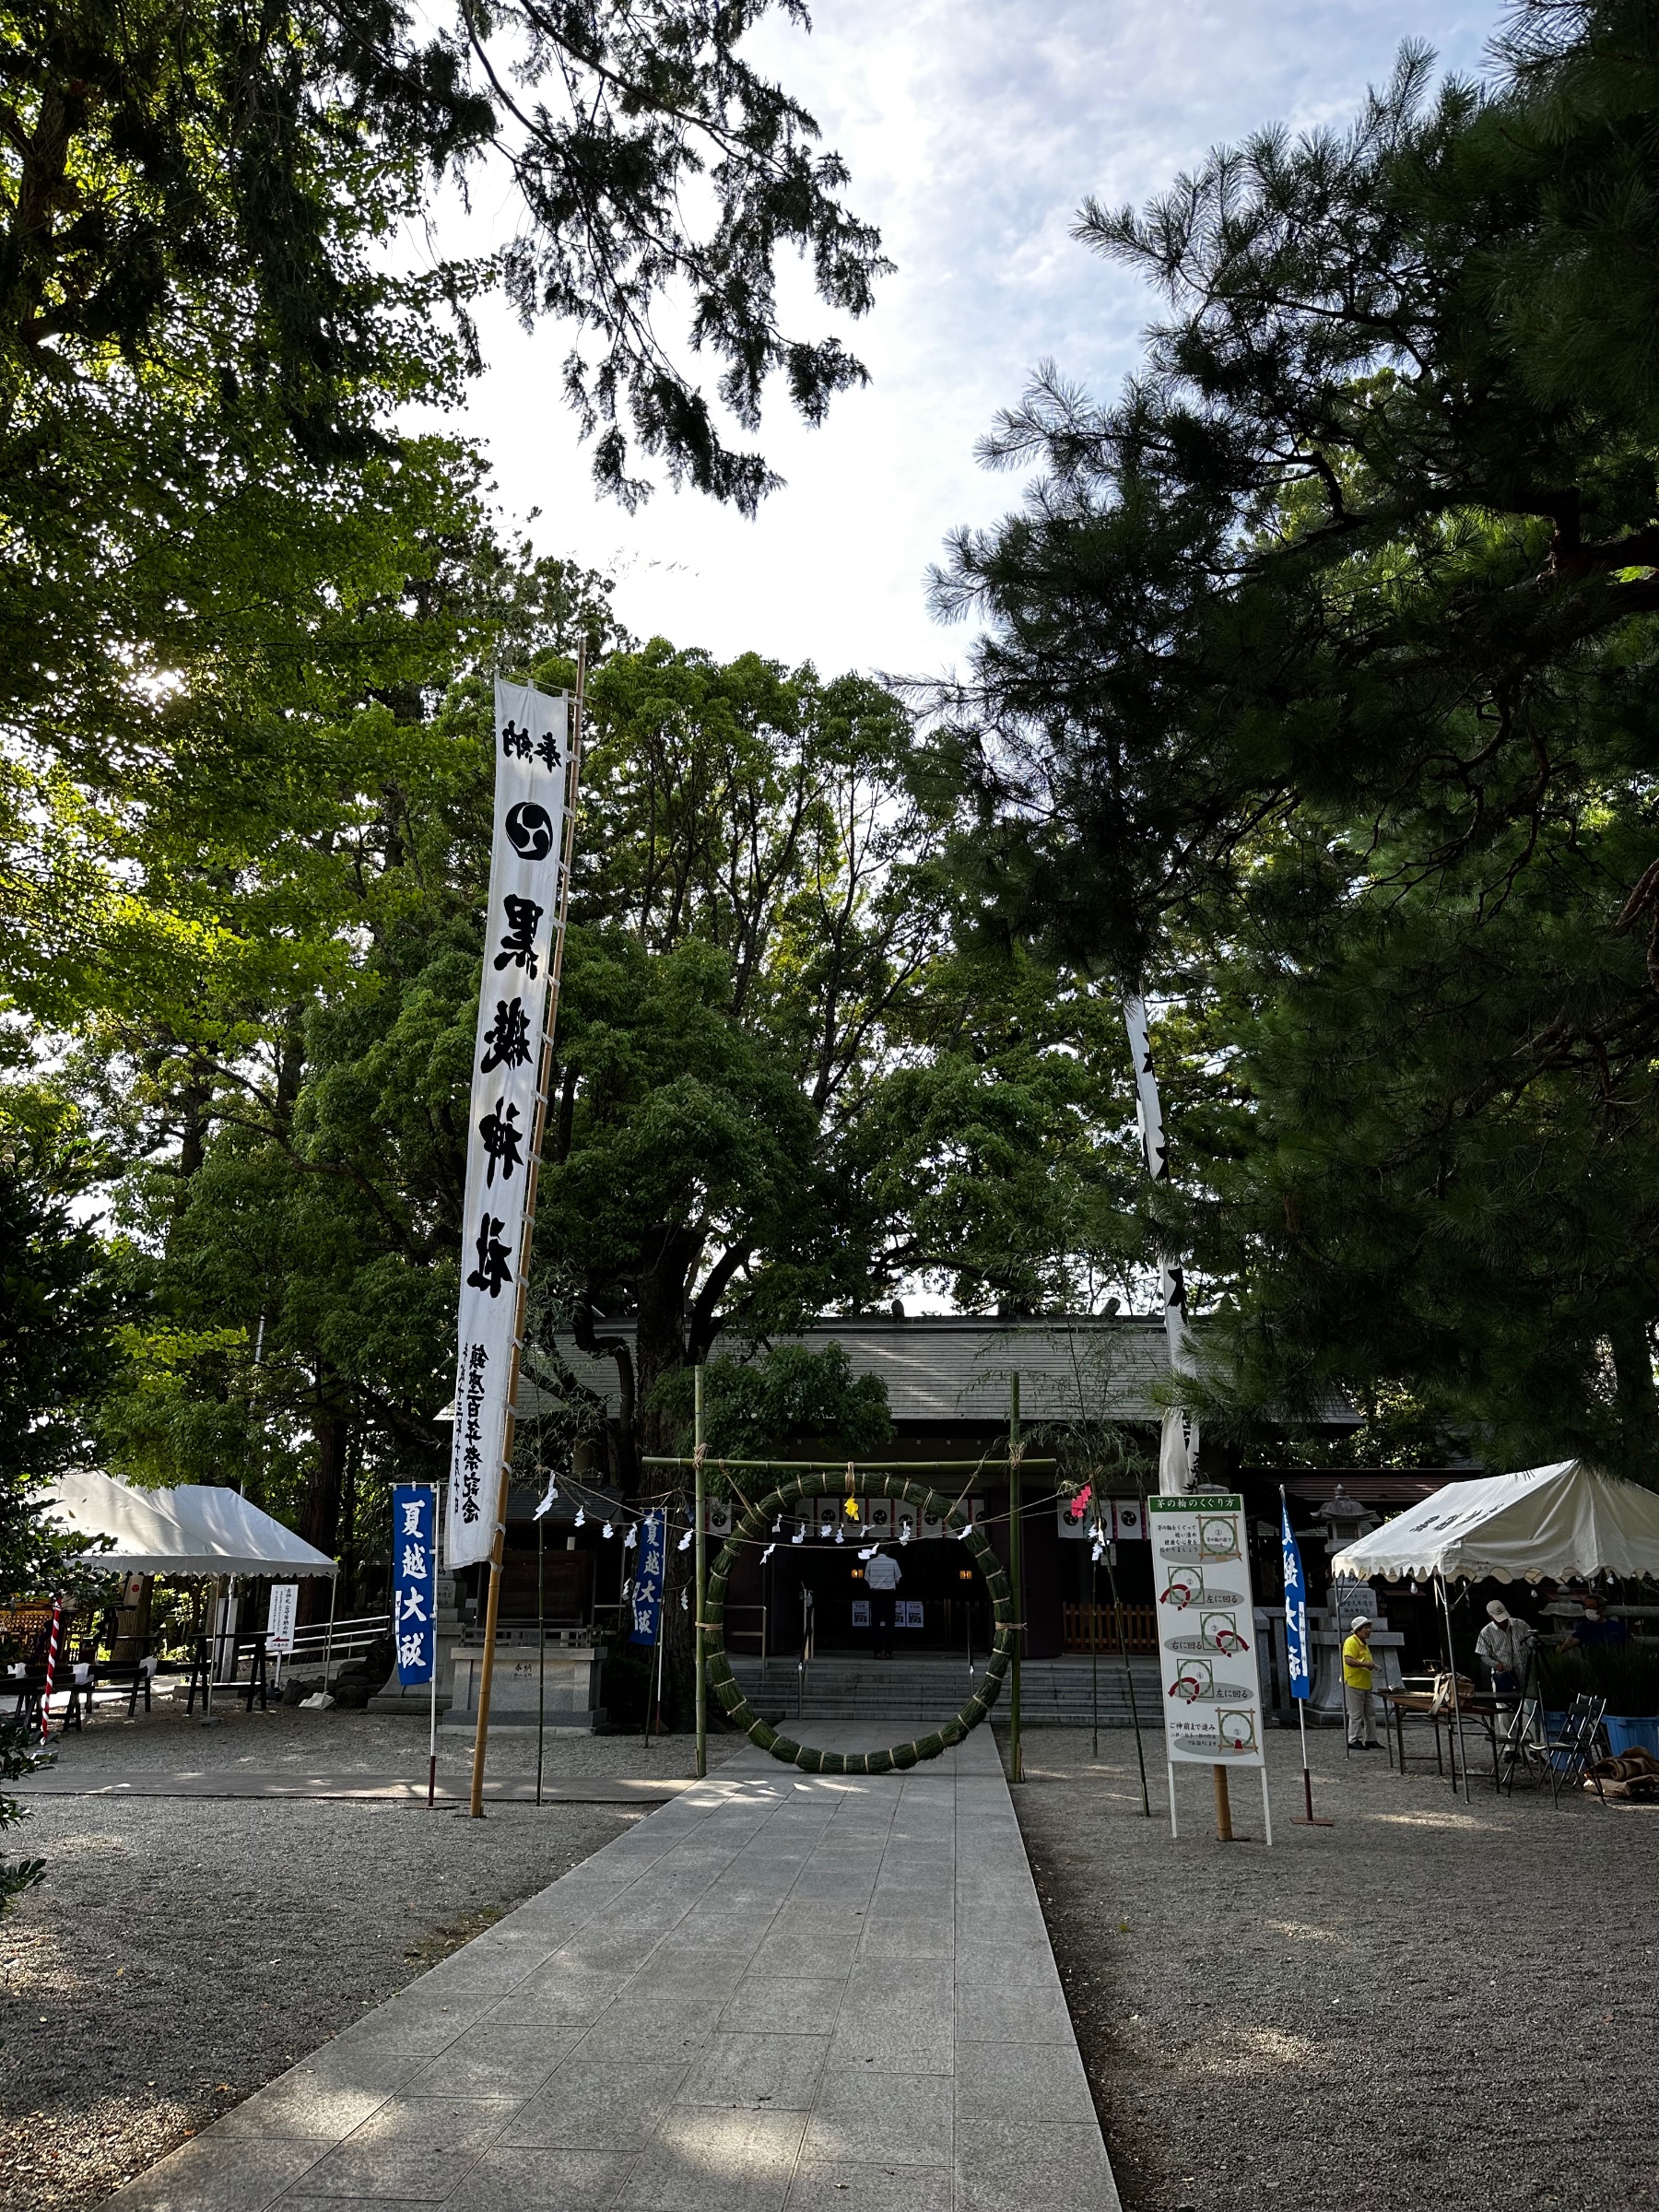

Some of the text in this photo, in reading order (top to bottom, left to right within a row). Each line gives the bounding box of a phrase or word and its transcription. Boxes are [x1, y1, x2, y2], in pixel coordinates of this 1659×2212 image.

[1157, 1498, 1235, 1509] 茅の輪のくぐり方
[637, 1517, 660, 1634] 夏越大祓
[400, 1500, 429, 1668] 夏越大祓
[1206, 1594, 1238, 1604] 左に回る
[1171, 1641, 1202, 1650] 右に回る
[1216, 1688, 1248, 1699] 左に回る
[1169, 1722, 1216, 1731] ご神前まで進み
